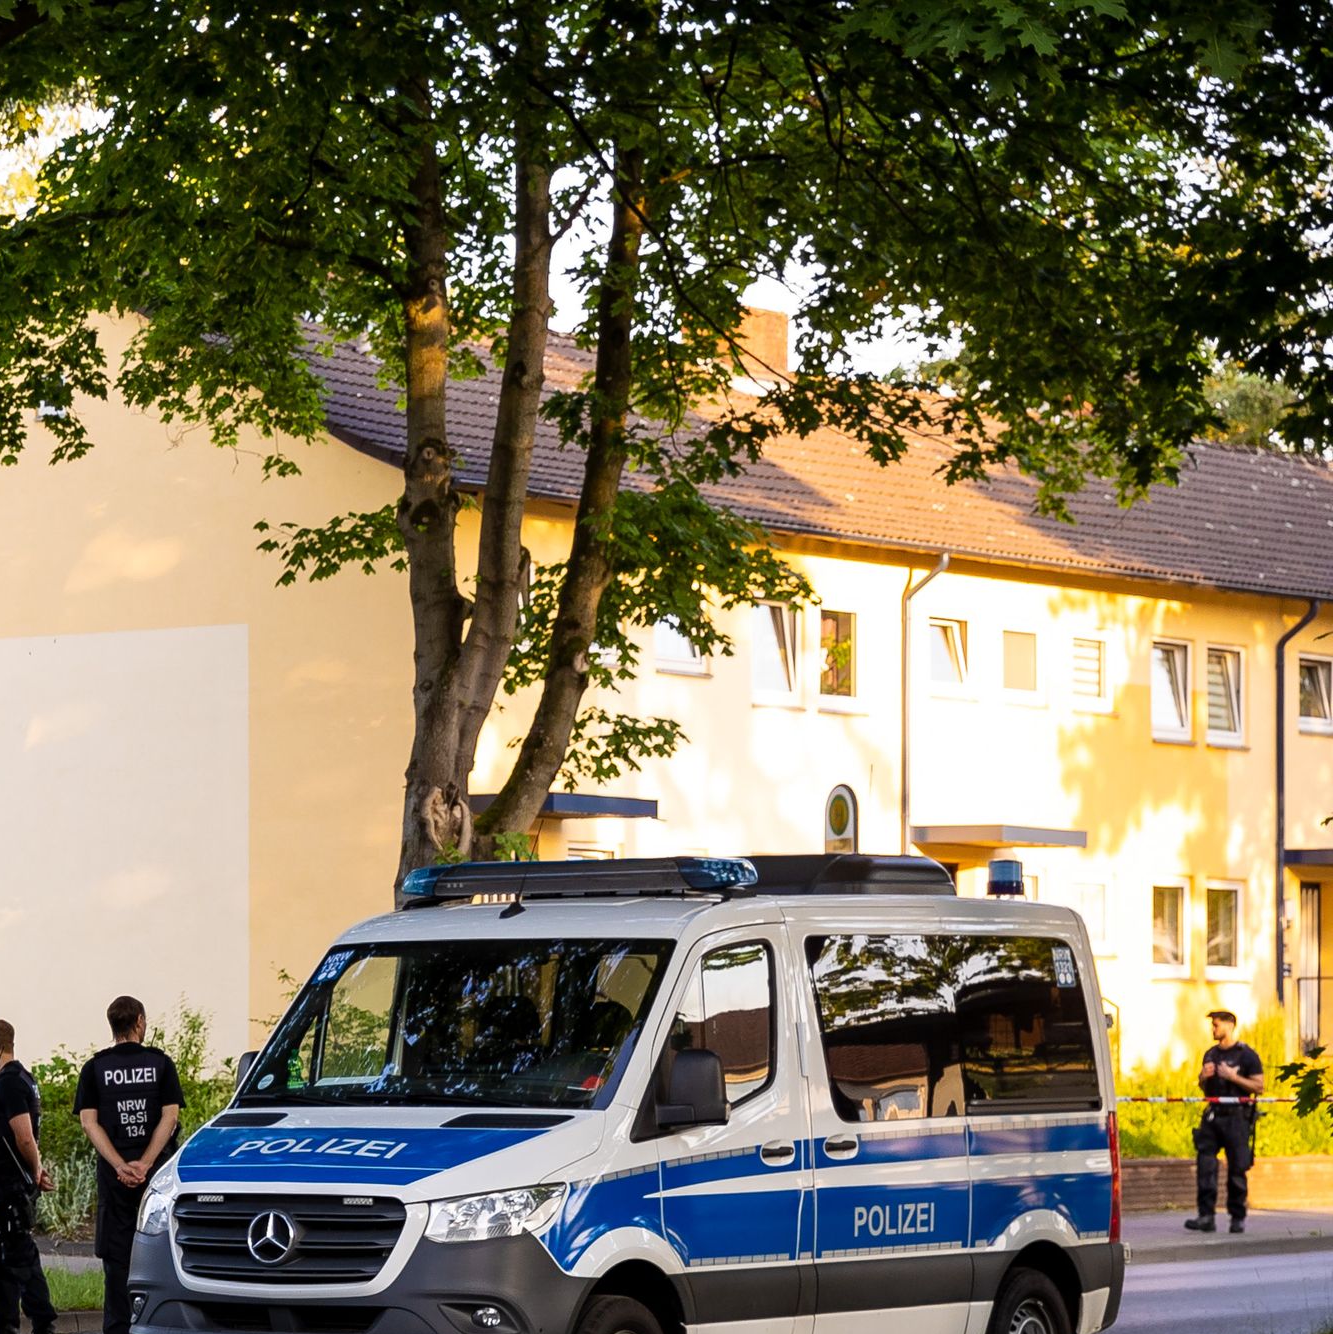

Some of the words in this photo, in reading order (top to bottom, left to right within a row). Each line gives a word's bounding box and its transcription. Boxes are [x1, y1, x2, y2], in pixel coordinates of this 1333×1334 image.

[104, 1067, 157, 1086] POLIZEI
[117, 1099, 146, 1112] NRW
[120, 1111, 148, 1124] BeSi
[126, 1125, 145, 1137] 134
[228, 1138, 409, 1159] POLIZEI
[854, 1202, 935, 1237] POLIZEI
